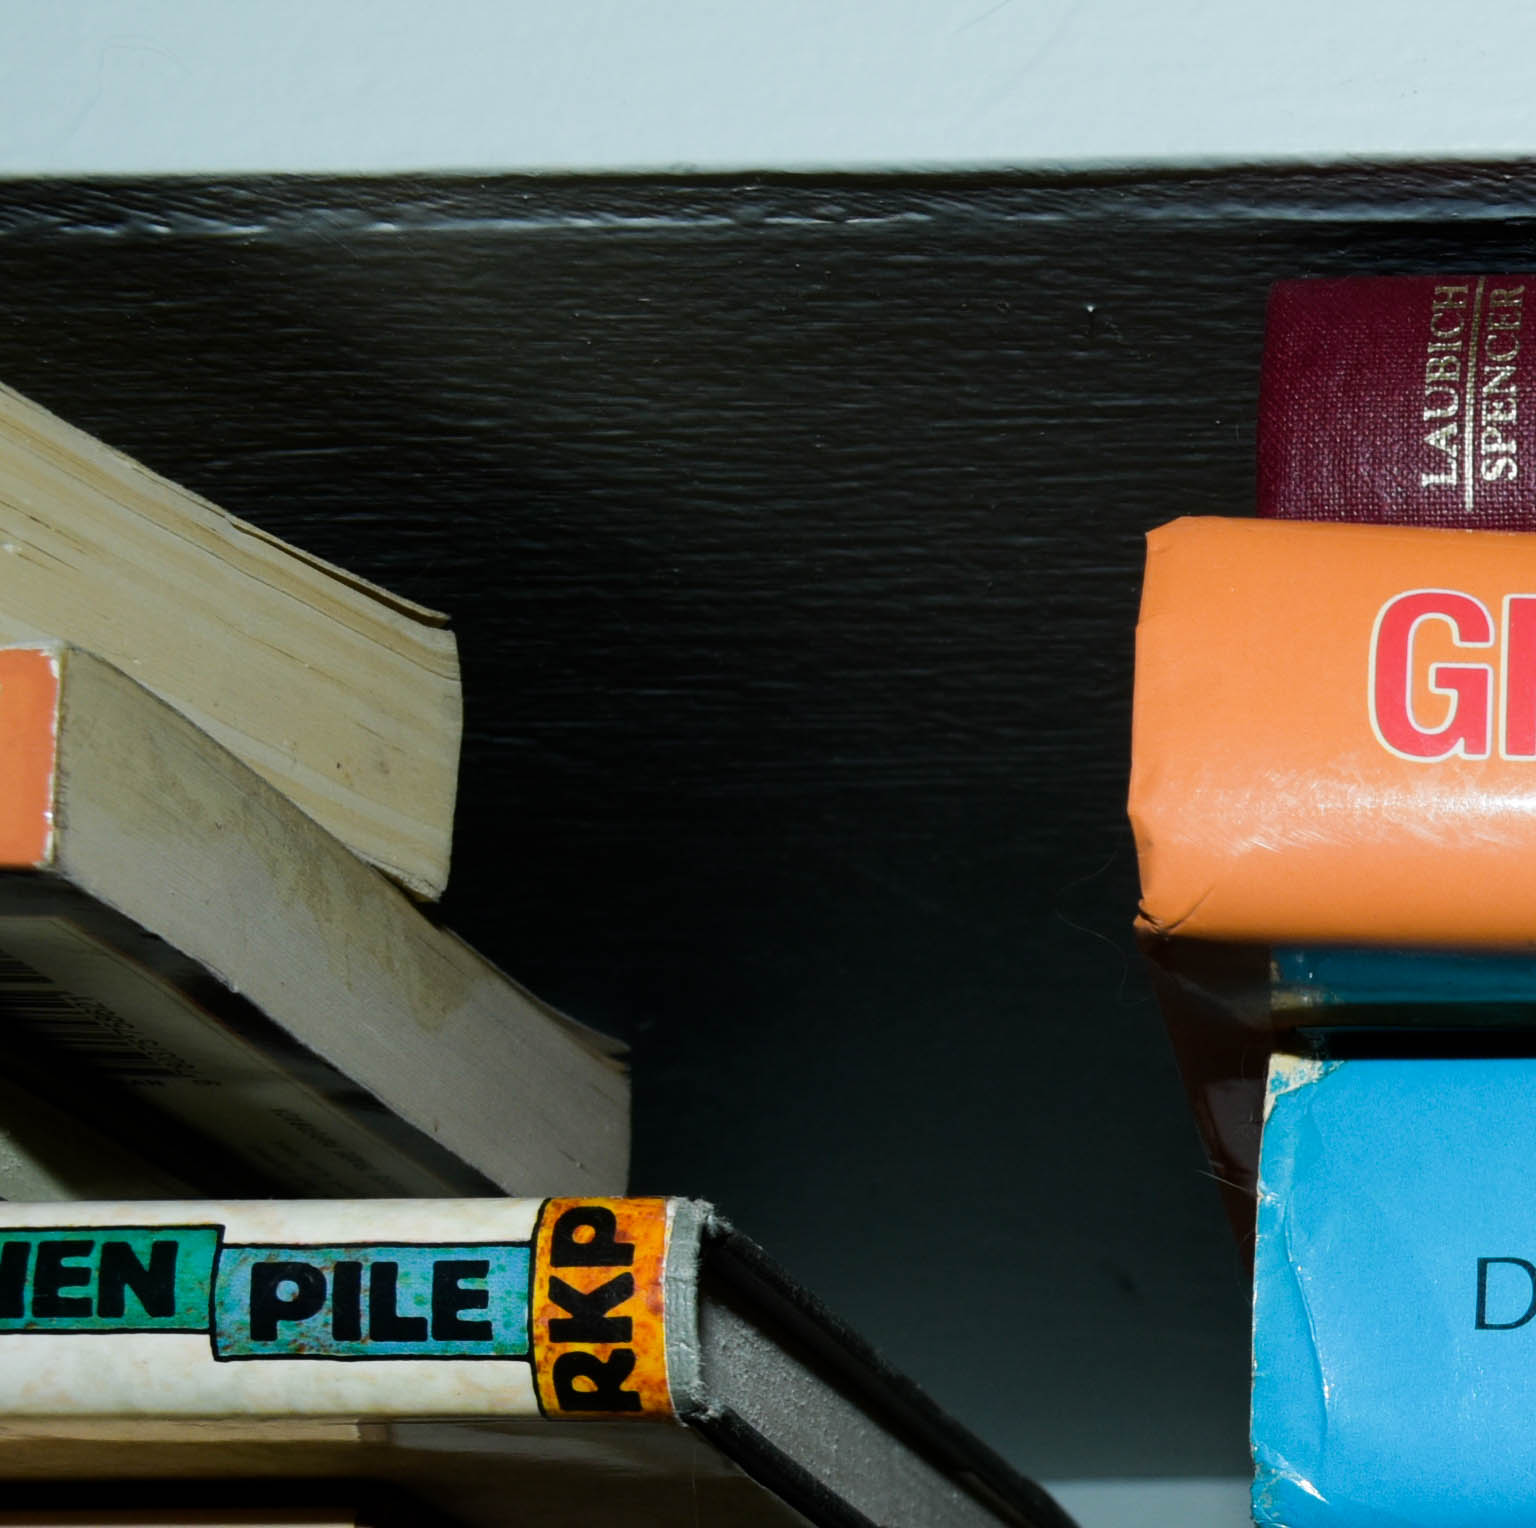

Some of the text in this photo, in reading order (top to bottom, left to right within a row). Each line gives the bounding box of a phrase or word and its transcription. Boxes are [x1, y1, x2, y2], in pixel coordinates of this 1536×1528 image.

[1421, 285, 1468, 488] LAUBICH
[1481, 284, 1525, 482] SPENCER
[250, 1259, 493, 1342] PILE
[548, 1205, 644, 1414] RKP
